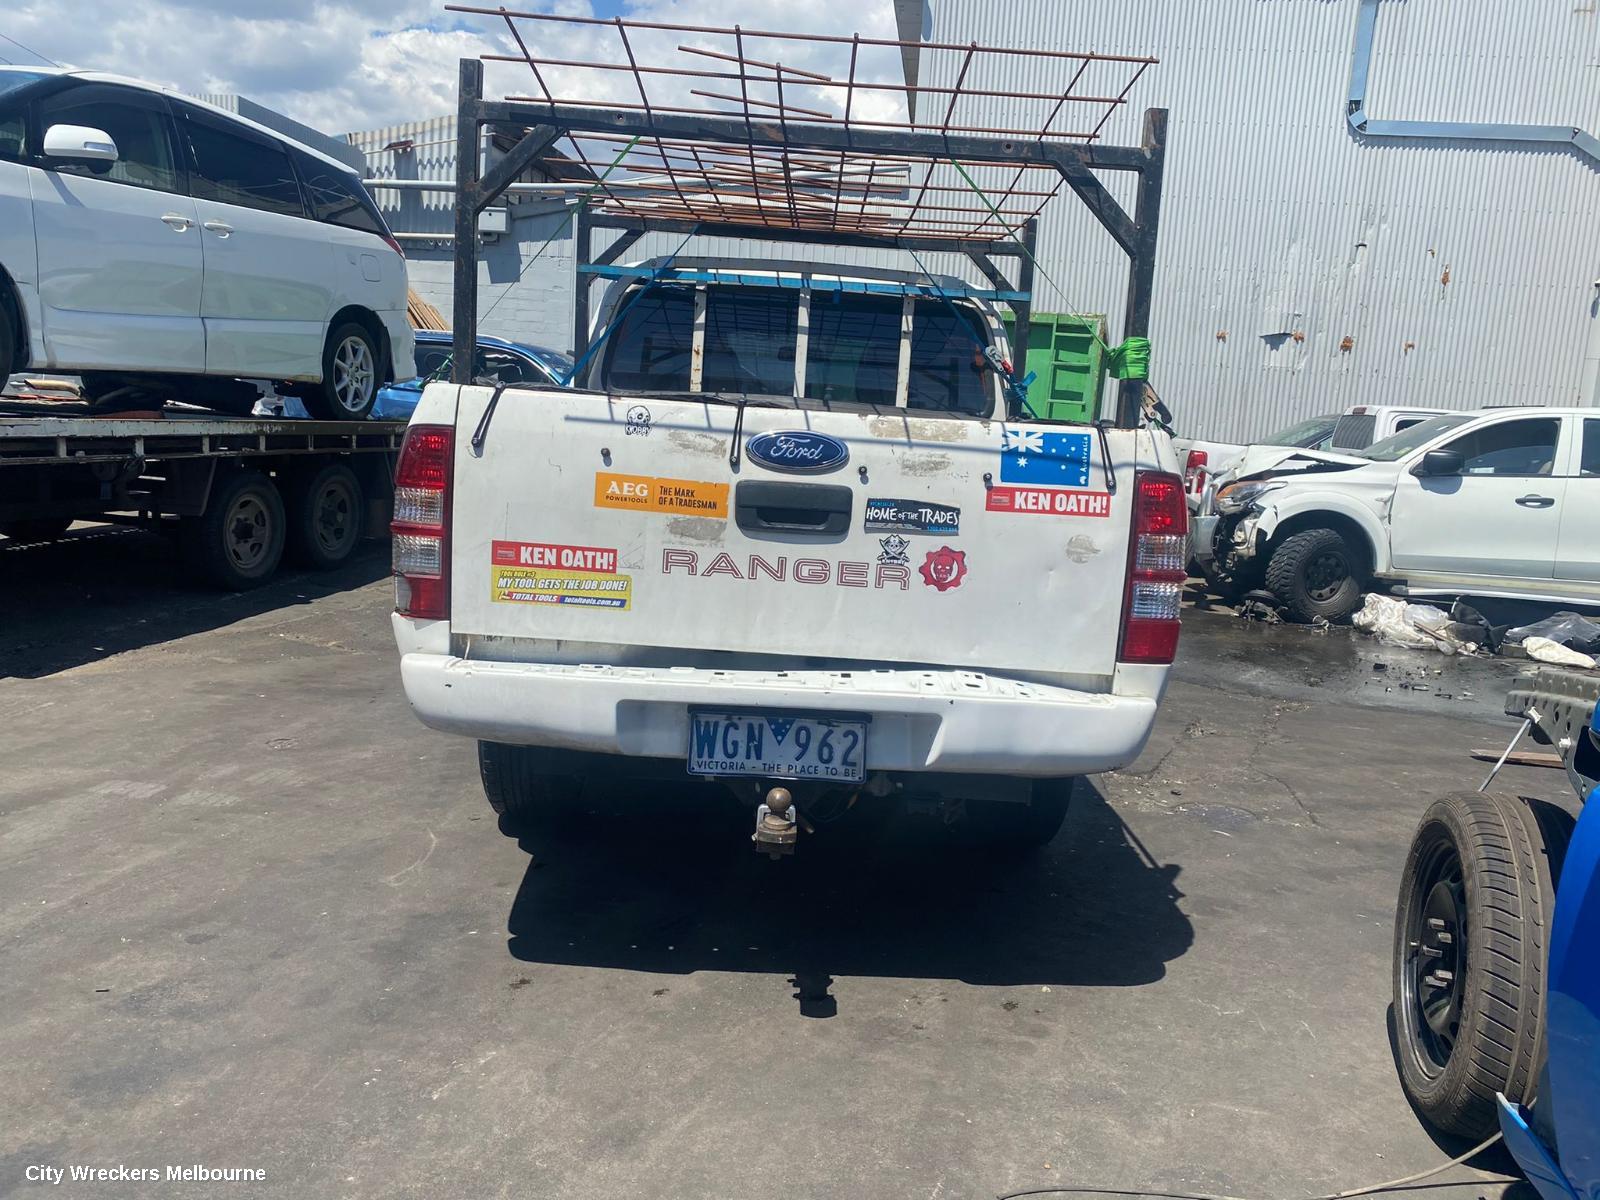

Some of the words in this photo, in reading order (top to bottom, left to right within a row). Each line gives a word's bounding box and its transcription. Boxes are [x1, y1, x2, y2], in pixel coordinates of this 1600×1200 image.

[770, 437, 824, 459] Ford
[1080, 436, 1089, 473] Australia
[606, 480, 649, 497] AEG
[660, 485, 673, 496] THE
[674, 487, 695, 498] MARK
[606, 495, 648, 504] POWERTOOLS
[659, 496, 668, 505] OF
[668, 497, 675, 505] A
[675, 497, 717, 510] TRADESMAN
[1014, 491, 1051, 511] KEN
[1055, 493, 1107, 514] OATH!
[866, 507, 898, 521] HOME
[918, 508, 958, 525] TRADES
[520, 546, 557, 566] KEN
[561, 549, 614, 570] OATH!
[662, 548, 911, 591] RANGER
[497, 577, 513, 589] MY
[513, 577, 536, 590] TOOL
[538, 578, 562, 590] GETS
[563, 579, 580, 590] THE
[580, 579, 598, 591] JOB
[599, 580, 627, 591] DONE!
[511, 592, 534, 601] TOTAL
[534, 593, 558, 602] TOOLS
[695, 719, 764, 761] WGN
[794, 725, 859, 767] 962
[697, 761, 746, 771] VICTORIA
[762, 763, 782, 773] THE
[787, 765, 819, 775] PLACE
[825, 766, 838, 776] TO
[844, 768, 857, 778] BE
